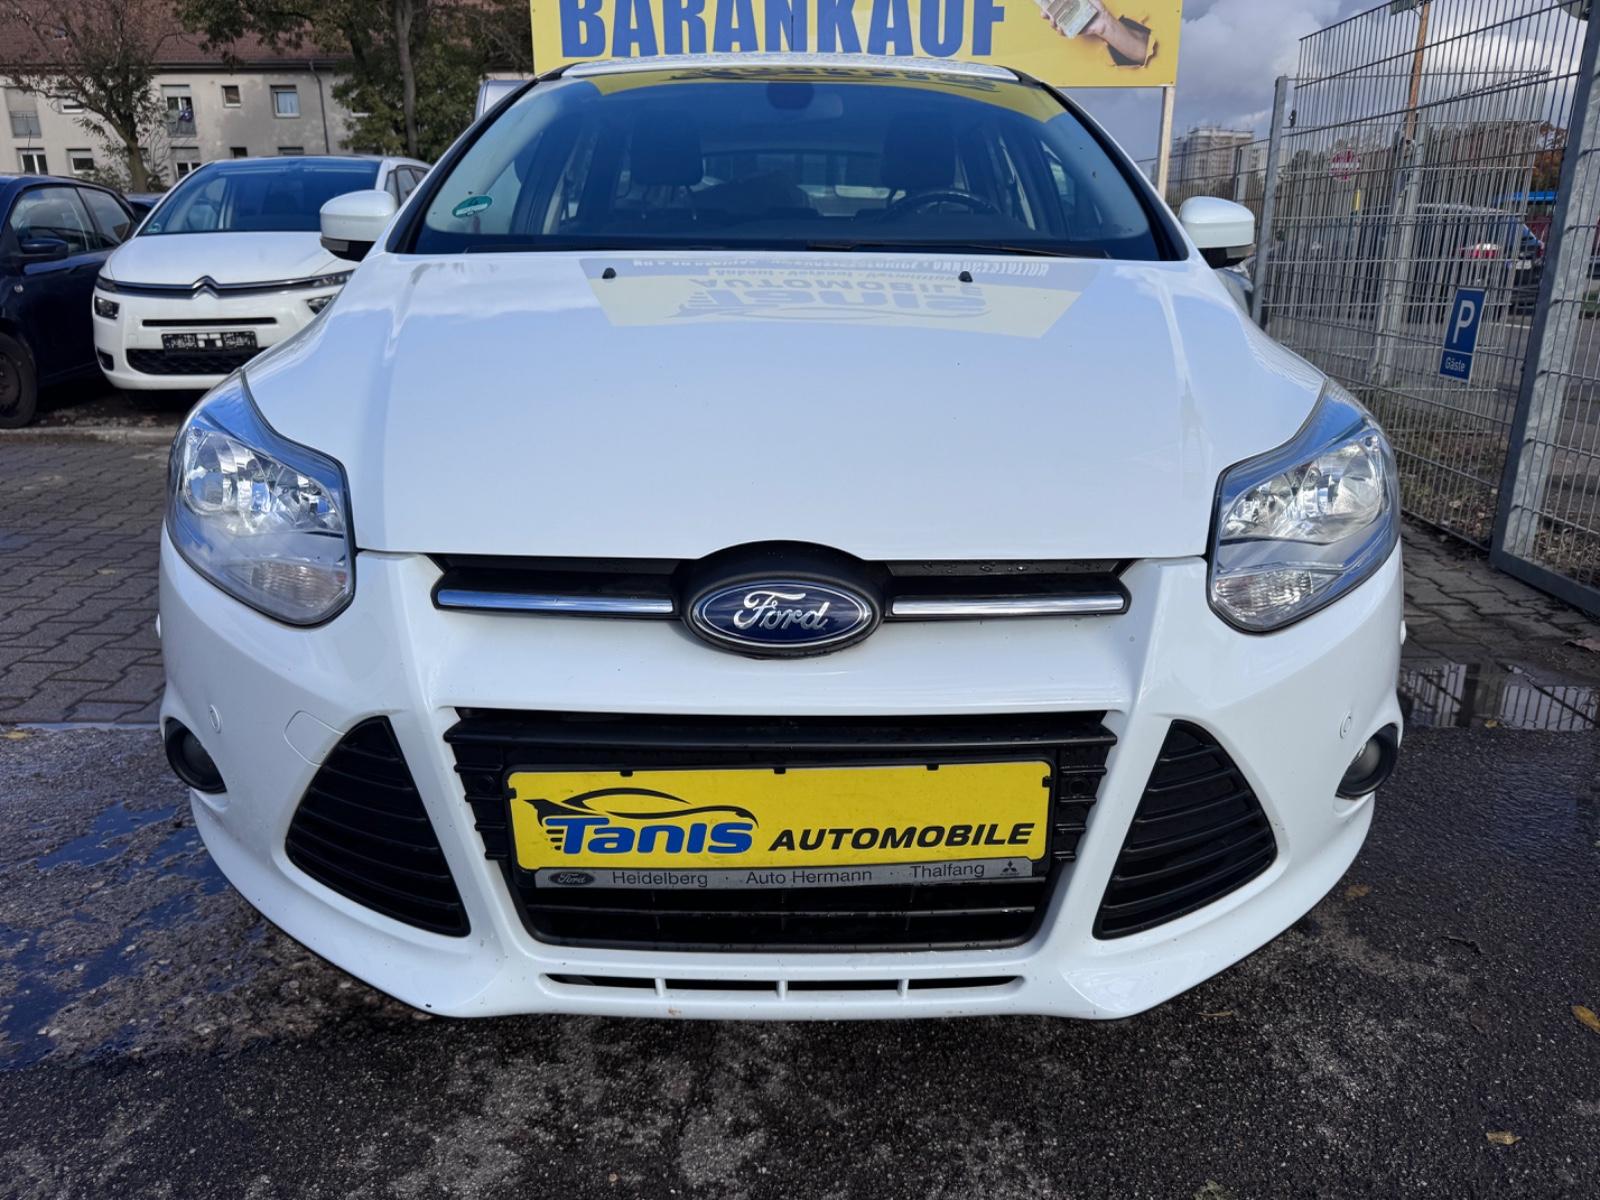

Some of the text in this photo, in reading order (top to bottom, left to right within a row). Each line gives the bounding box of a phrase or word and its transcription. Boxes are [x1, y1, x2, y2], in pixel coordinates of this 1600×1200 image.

[558, 0, 1005, 57] BARANKAUF
[1453, 300, 1475, 343] P
[1444, 356, 1466, 372] Gäste
[733, 590, 831, 630] Ford
[768, 823, 1035, 851] AUTOMOBILE
[612, 871, 708, 888] Heidelberg
[746, 870, 786, 885] Auto
[791, 869, 873, 884] Hermann
[910, 862, 985, 879] Thalfang
